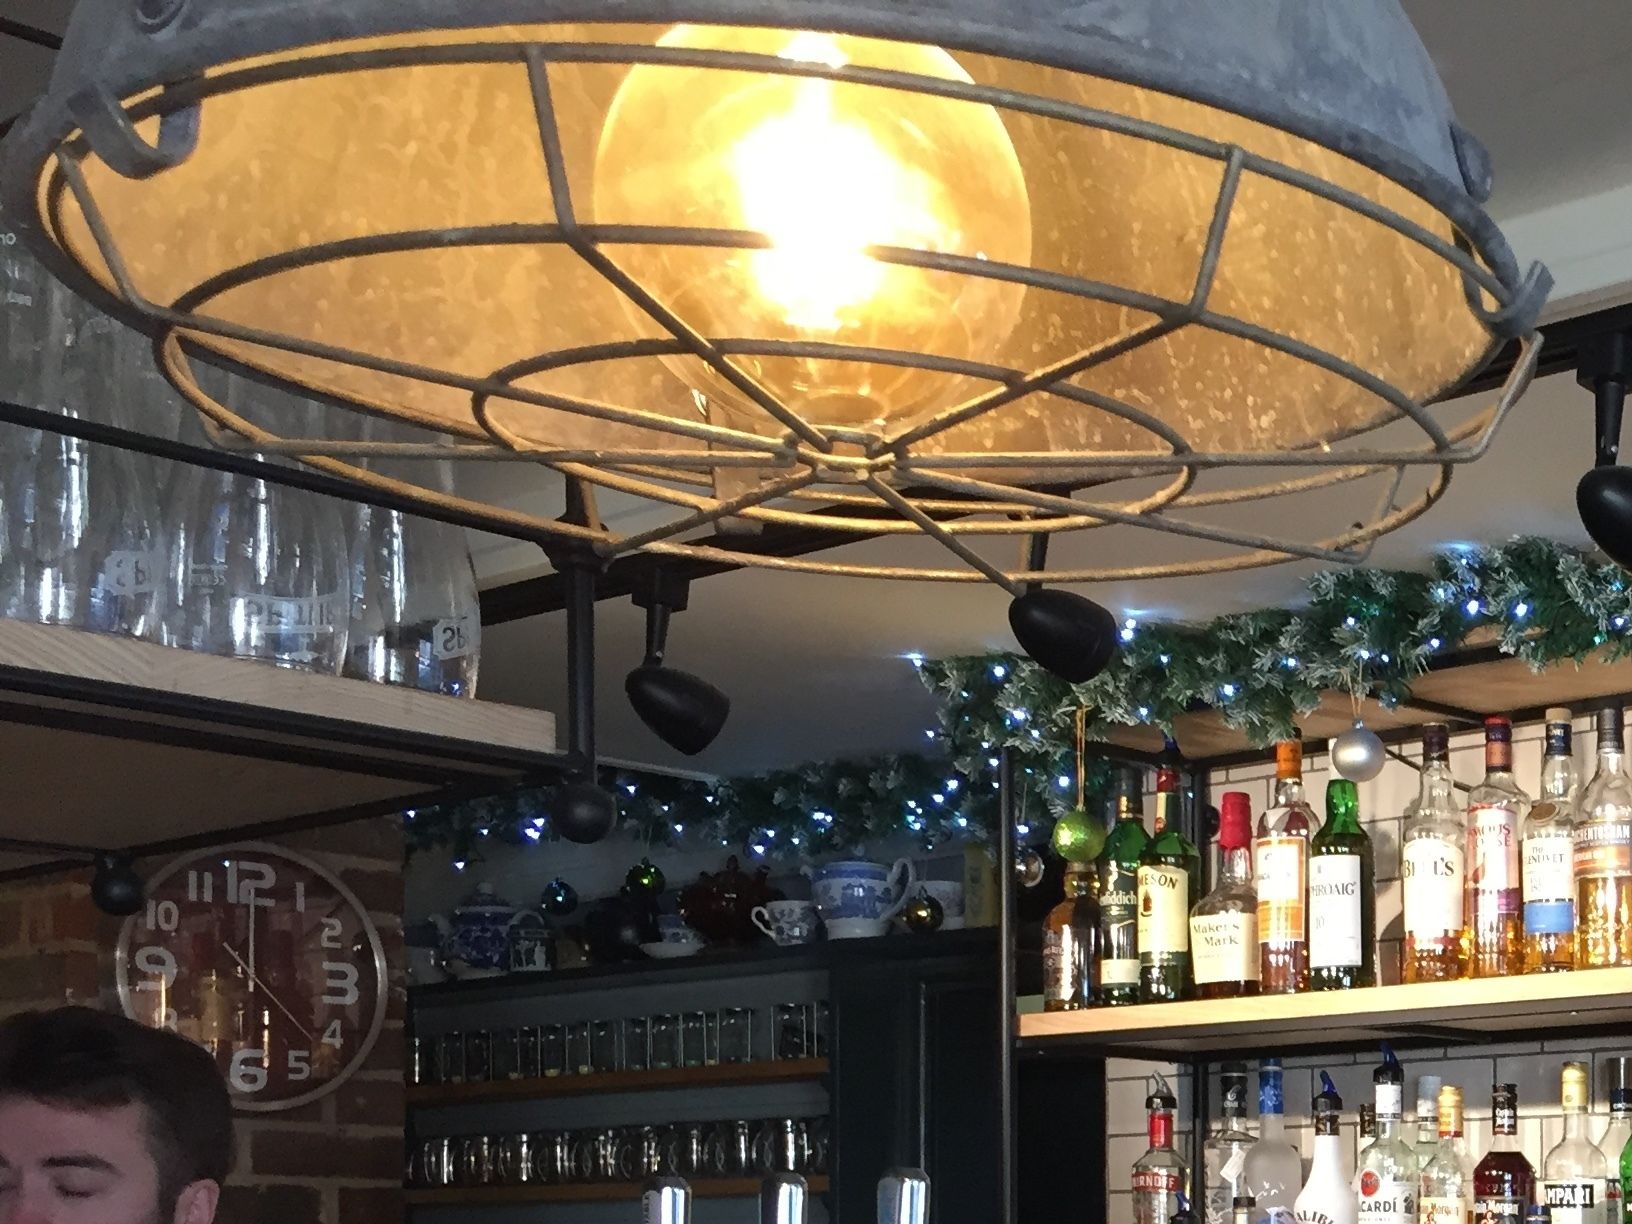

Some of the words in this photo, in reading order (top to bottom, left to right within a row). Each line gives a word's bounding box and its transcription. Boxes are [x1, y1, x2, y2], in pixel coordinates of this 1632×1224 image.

[187, 870, 213, 903] 11
[226, 861, 277, 907] 12
[295, 881, 305, 913] 1
[146, 899, 180, 931] 10
[320, 917, 342, 949] 2
[1203, 934, 1240, 948] Mark
[134, 945, 178, 993] 9
[321, 960, 360, 1006] 3
[322, 1019, 344, 1049] 4
[229, 1048, 269, 1093] 6
[287, 1050, 311, 1081] 5
